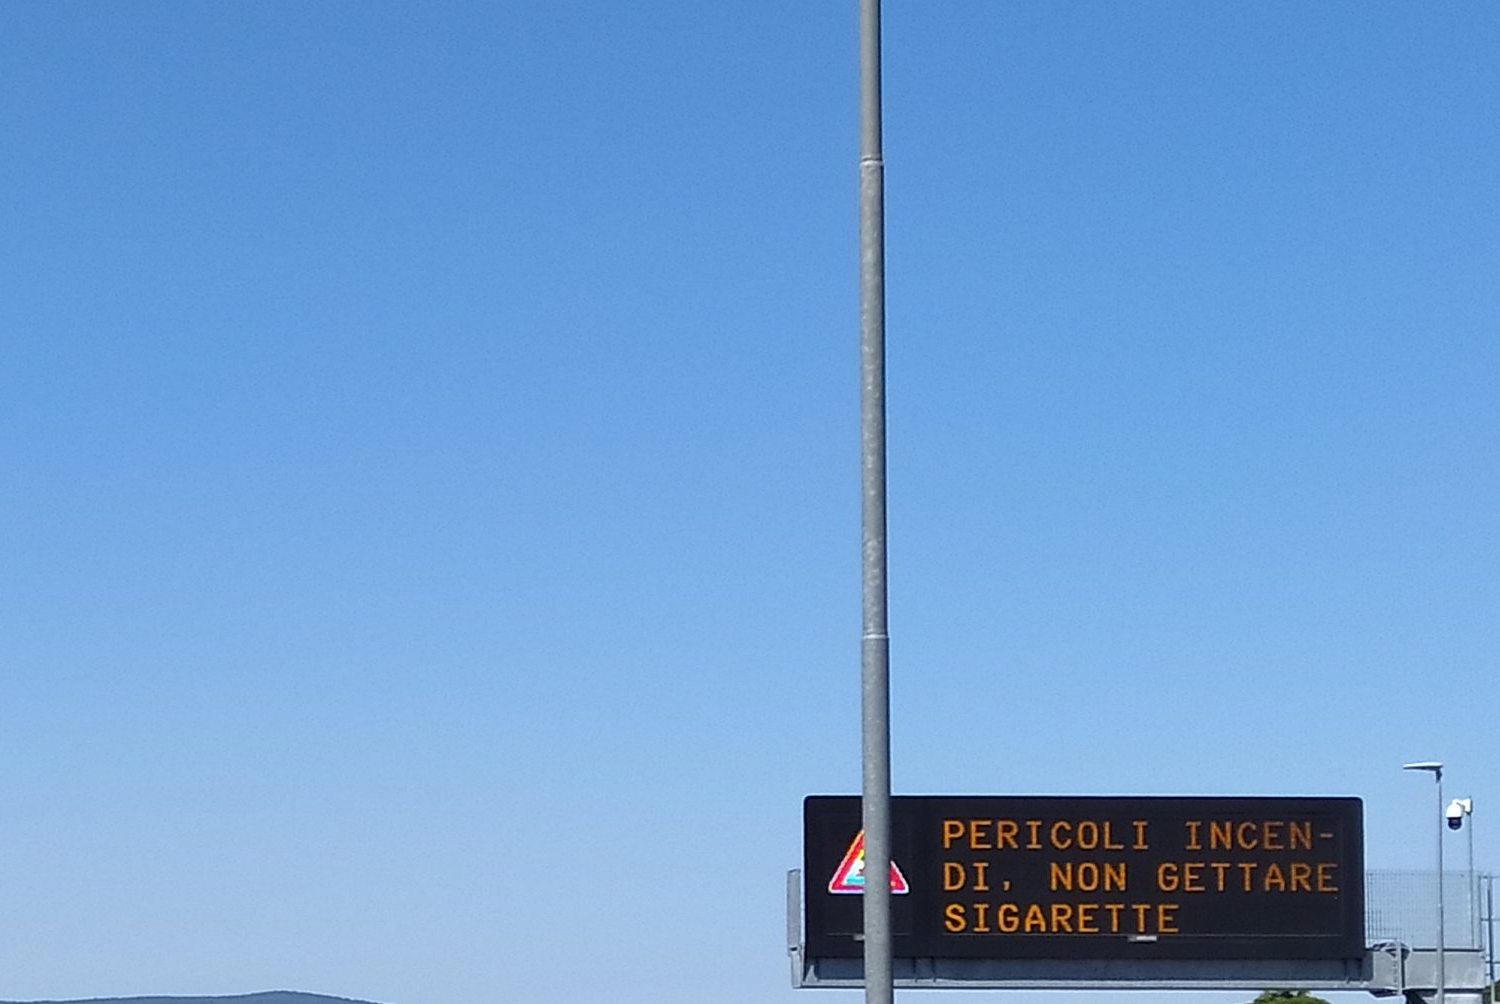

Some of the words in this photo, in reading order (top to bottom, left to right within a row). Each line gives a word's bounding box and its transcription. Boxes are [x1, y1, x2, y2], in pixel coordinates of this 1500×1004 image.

[942, 820, 1150, 850] PERICOLI
[943, 862, 1012, 892] DI,
[1051, 862, 1127, 892] NON
[1158, 862, 1339, 893] GETTARE
[945, 903, 1180, 933] SIGARETTE
